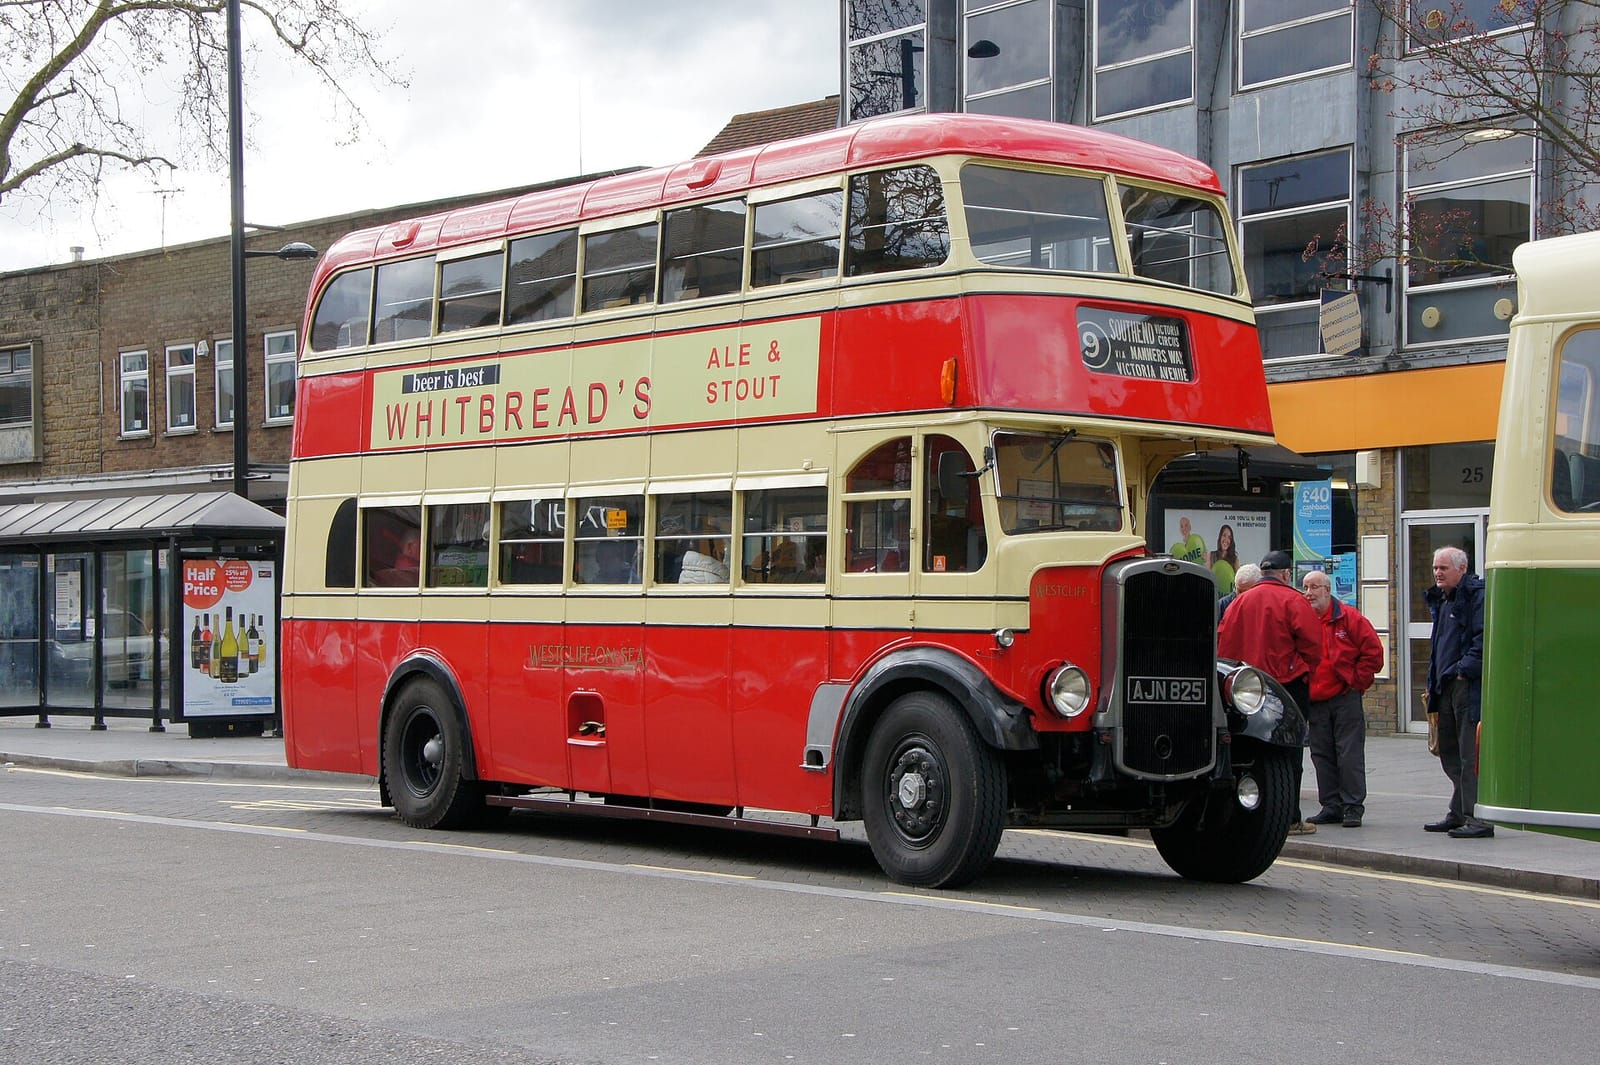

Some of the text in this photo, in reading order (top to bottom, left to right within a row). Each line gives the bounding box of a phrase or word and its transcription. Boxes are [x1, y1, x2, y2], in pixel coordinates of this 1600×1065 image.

[1108, 318, 1155, 345] SOUTHEND
[1154, 323, 1180, 337] VICTORIA
[1082, 331, 1100, 358] 9
[1157, 335, 1181, 348] CIRCUS
[706, 339, 781, 370] ALE &
[1114, 349, 1127, 359] VIA
[1129, 345, 1168, 364] MANNERS
[1115, 361, 1190, 382] VICTORIA AVENUE
[412, 368, 485, 394] beer is best
[706, 375, 781, 405] STOUT
[385, 376, 653, 441] WHITBREAD'S
[1462, 467, 1484, 484] 25
[1302, 486, 1330, 504] £40
[1180, 547, 1201, 563] OME
[187, 568, 216, 581] Half
[225, 569, 239, 577] 25%
[184, 582, 218, 596] Price
[1035, 583, 1087, 598] WESTCLIFF
[1132, 680, 1202, 701] AJN 825
